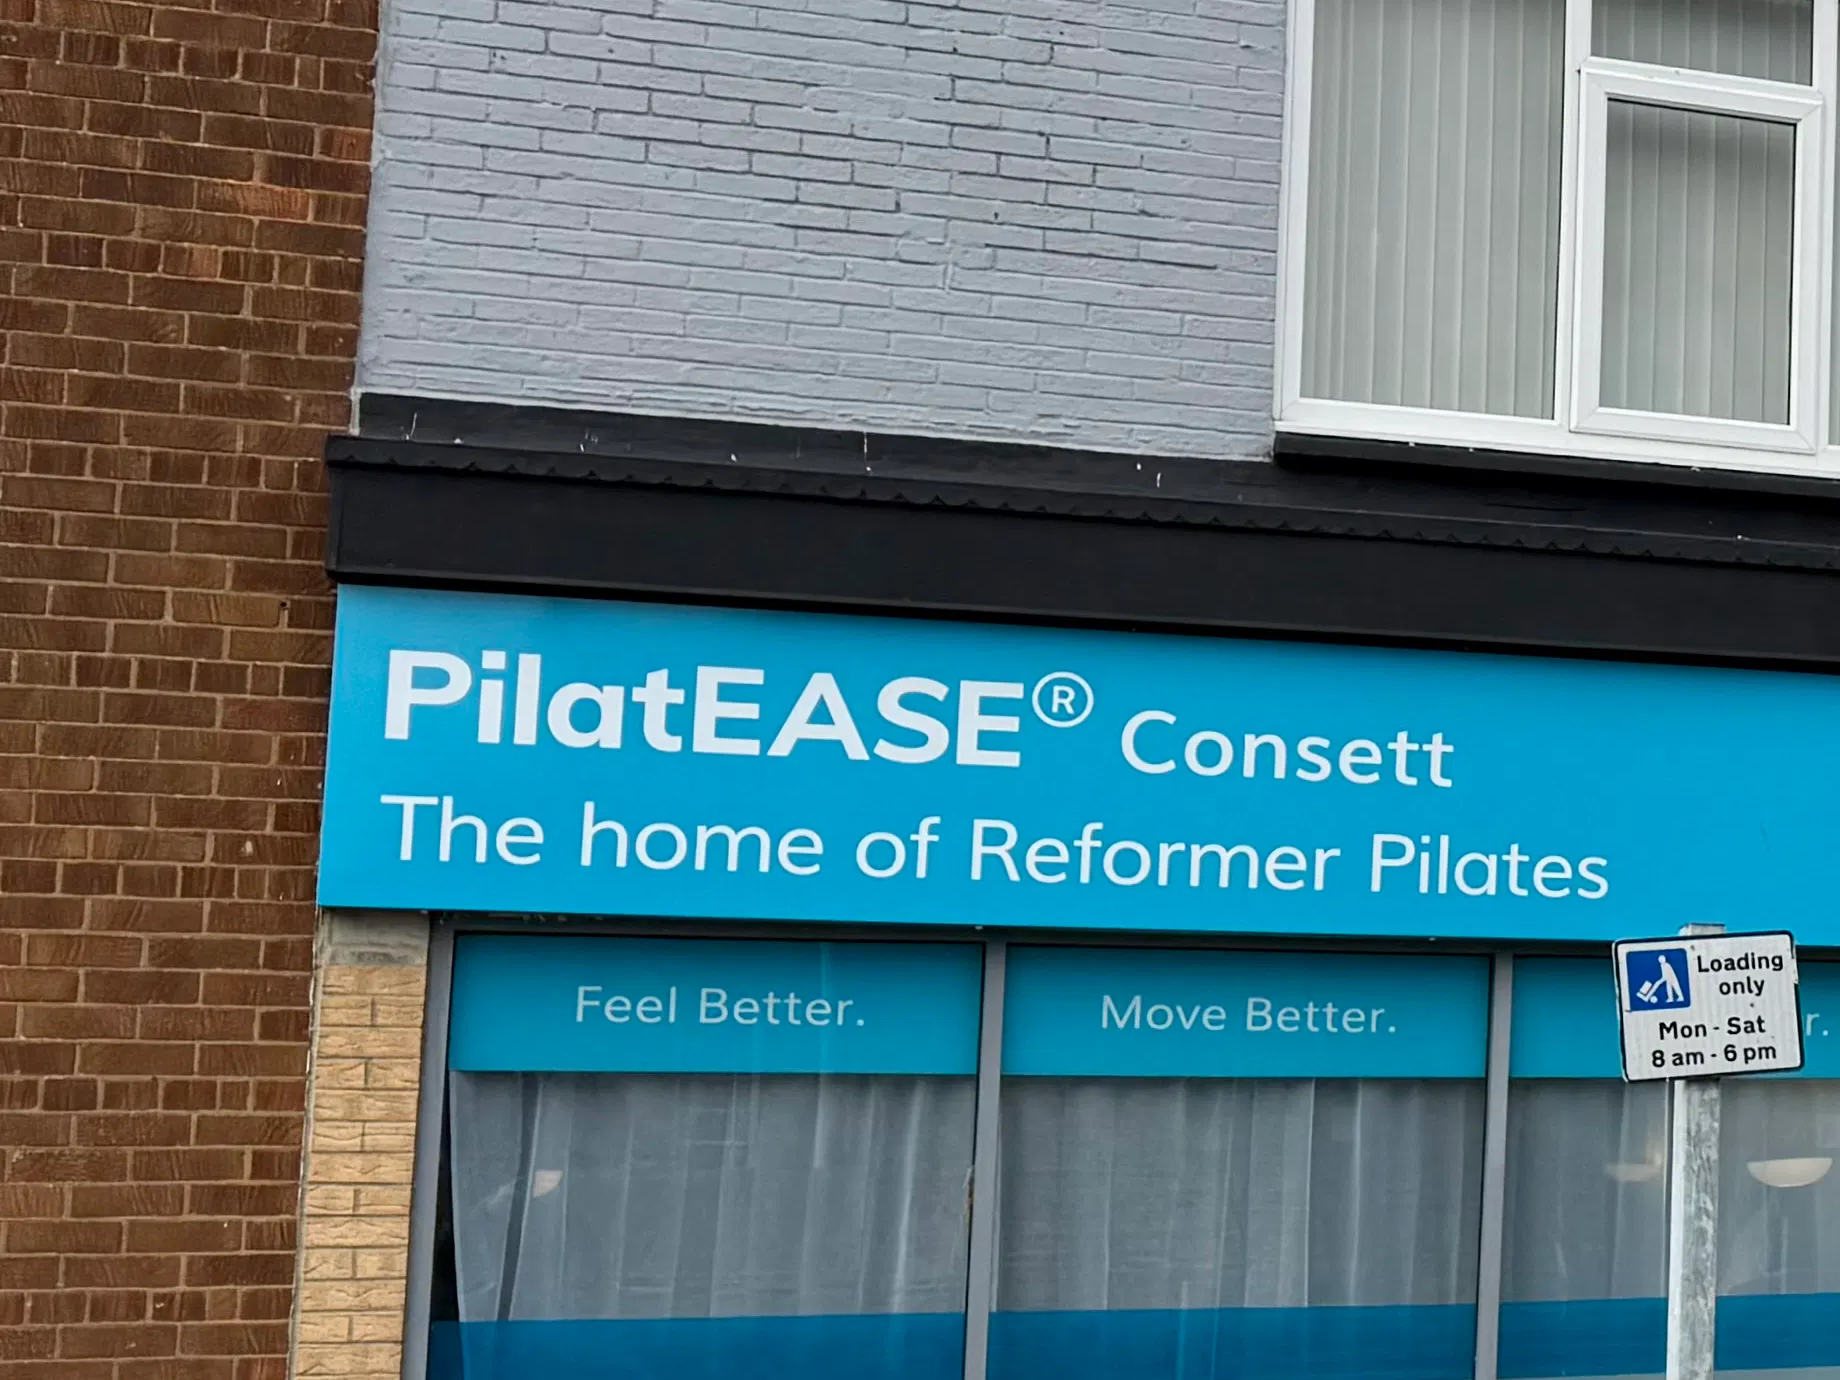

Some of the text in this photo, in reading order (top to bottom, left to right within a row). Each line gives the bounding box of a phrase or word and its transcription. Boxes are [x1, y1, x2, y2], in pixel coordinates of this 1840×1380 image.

[1121, 709, 1454, 788] Consett
[380, 793, 1609, 900] The home of Reformer Pilates
[1697, 952, 1784, 972] Loading
[1719, 976, 1765, 997] only
[575, 985, 867, 1027] Feel Better.
[1102, 994, 1397, 1035] Move Better.
[1659, 1022, 1708, 1040] Mon
[1727, 1015, 1766, 1036] Sat
[1652, 1049, 1666, 1068] 8
[1672, 1050, 1705, 1067] am
[1723, 1044, 1738, 1063] 6
[1743, 1045, 1777, 1064] pm
